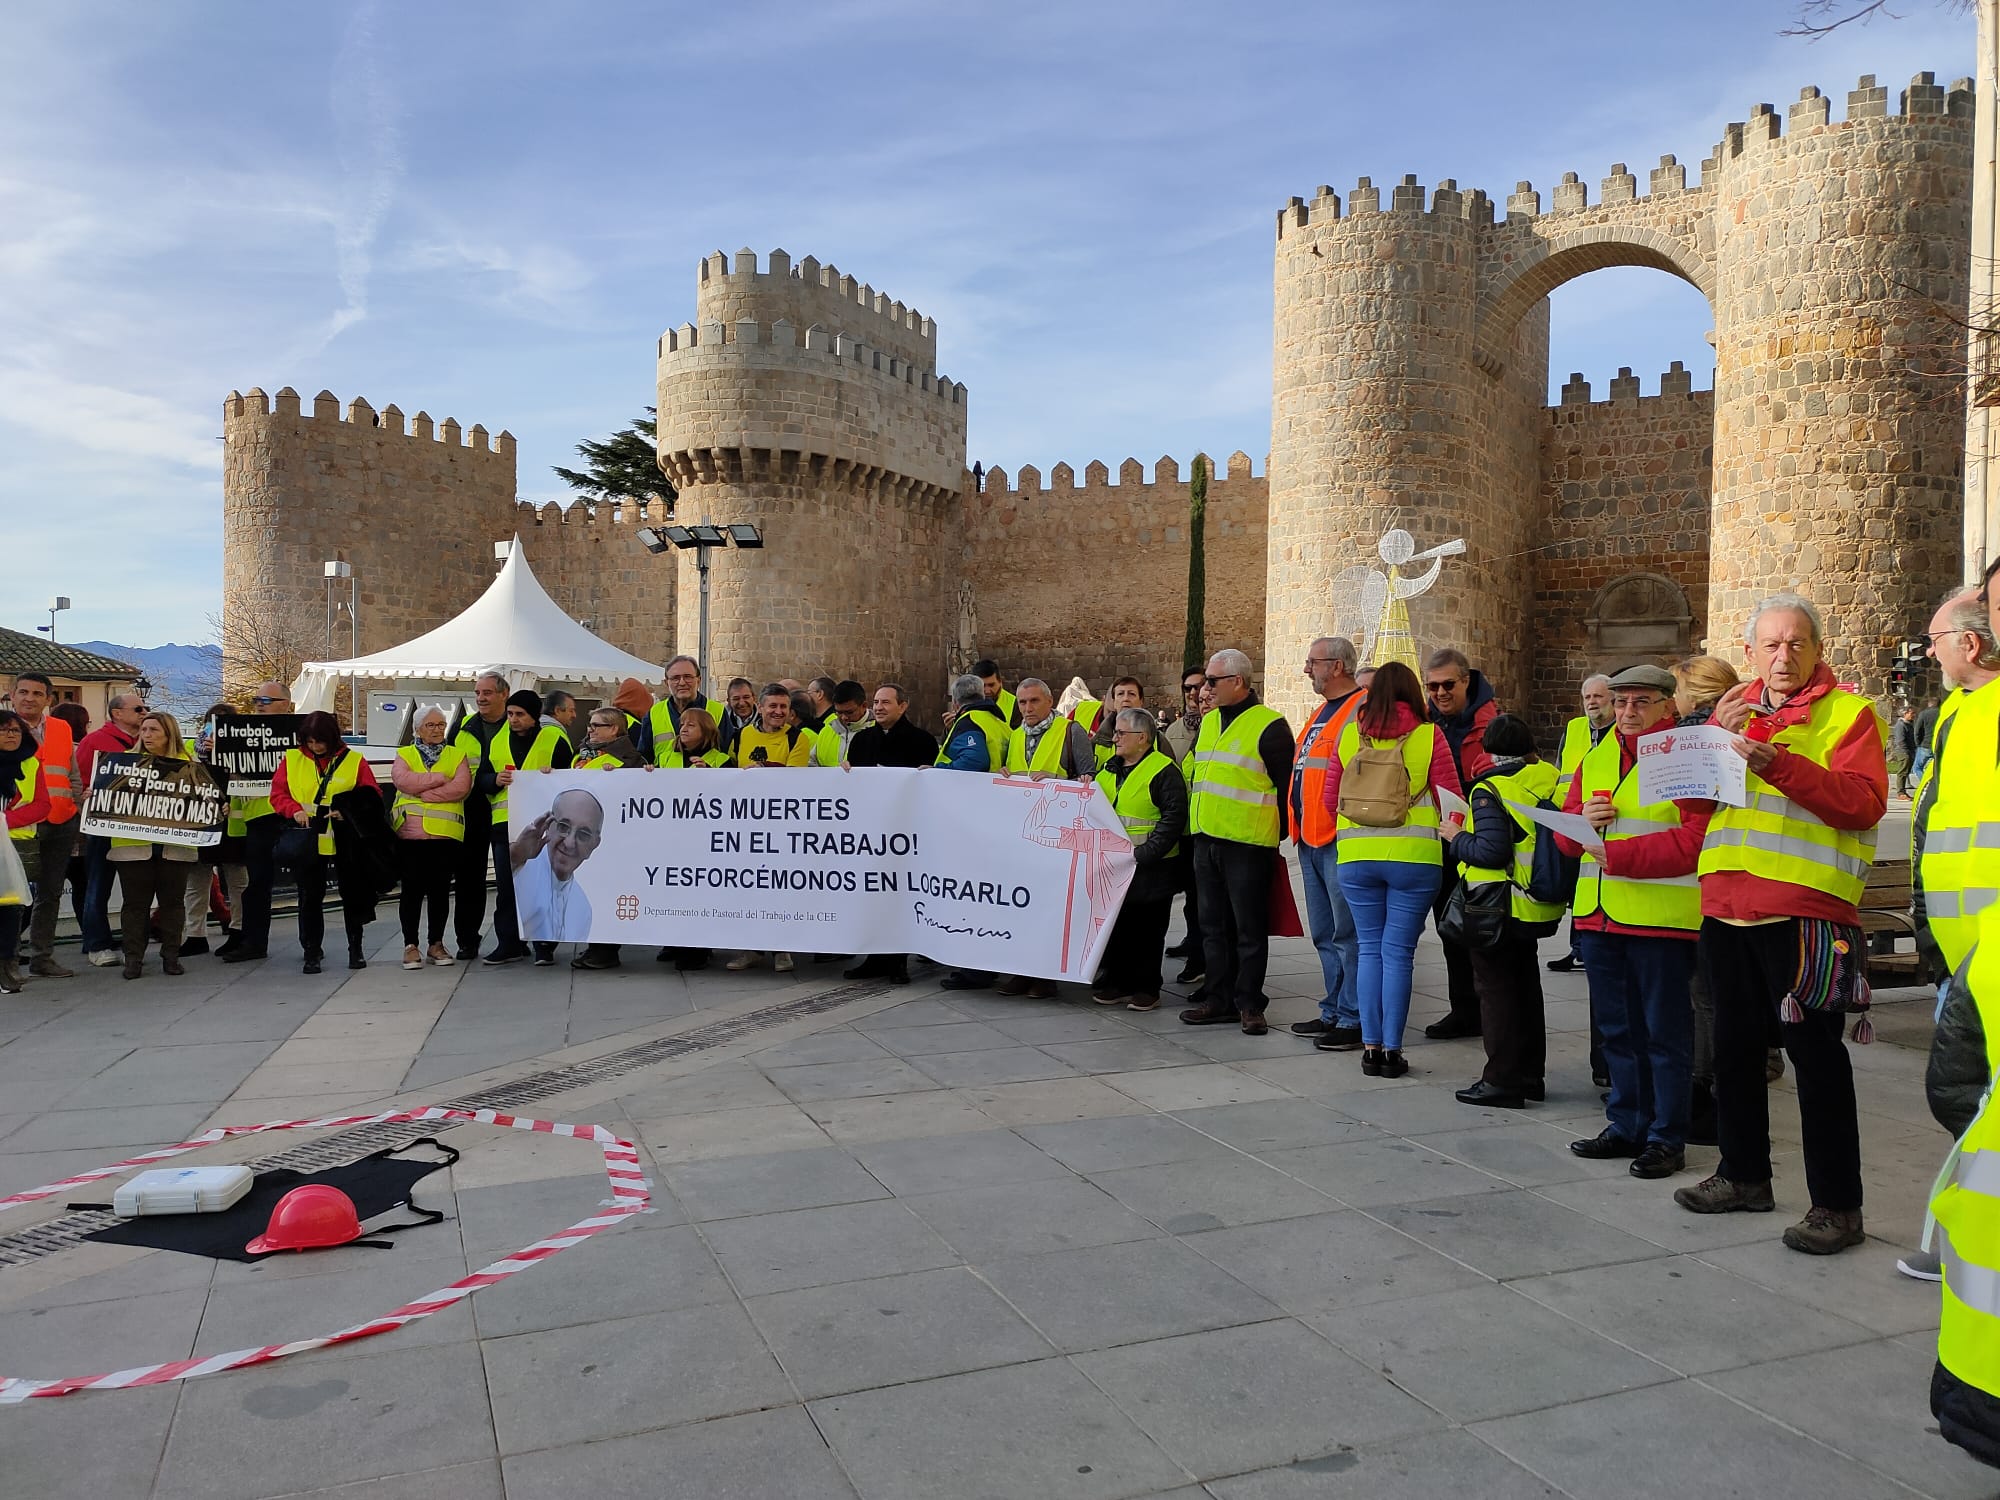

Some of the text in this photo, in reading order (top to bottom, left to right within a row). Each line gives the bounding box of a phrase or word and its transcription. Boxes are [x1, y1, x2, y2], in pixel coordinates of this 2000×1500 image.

[217, 723, 273, 740] el trabajo
[246, 737, 259, 747] es
[262, 736, 290, 750] para
[1680, 742, 1729, 751] BALEARS
[99, 761, 159, 780] el trabajo
[238, 751, 256, 773] UN
[128, 776, 220, 800] es para la vida
[90, 788, 113, 812] ¡NI
[114, 791, 134, 815] UN
[135, 793, 185, 821] MUERTO
[620, 793, 850, 824] ¡NO MÁS MUERTES
[85, 817, 98, 828] NO
[107, 819, 115, 829] la
[117, 821, 169, 836] siniestralidad
[171, 826, 199, 839] laboral
[711, 831, 918, 856] EN EL TRABAJO!
[644, 864, 1031, 908] Y ESFORCÉMONOS EN LOGRARLO
[644, 906, 838, 923] Departamento de Pastoral del Trabajo de la CEE
